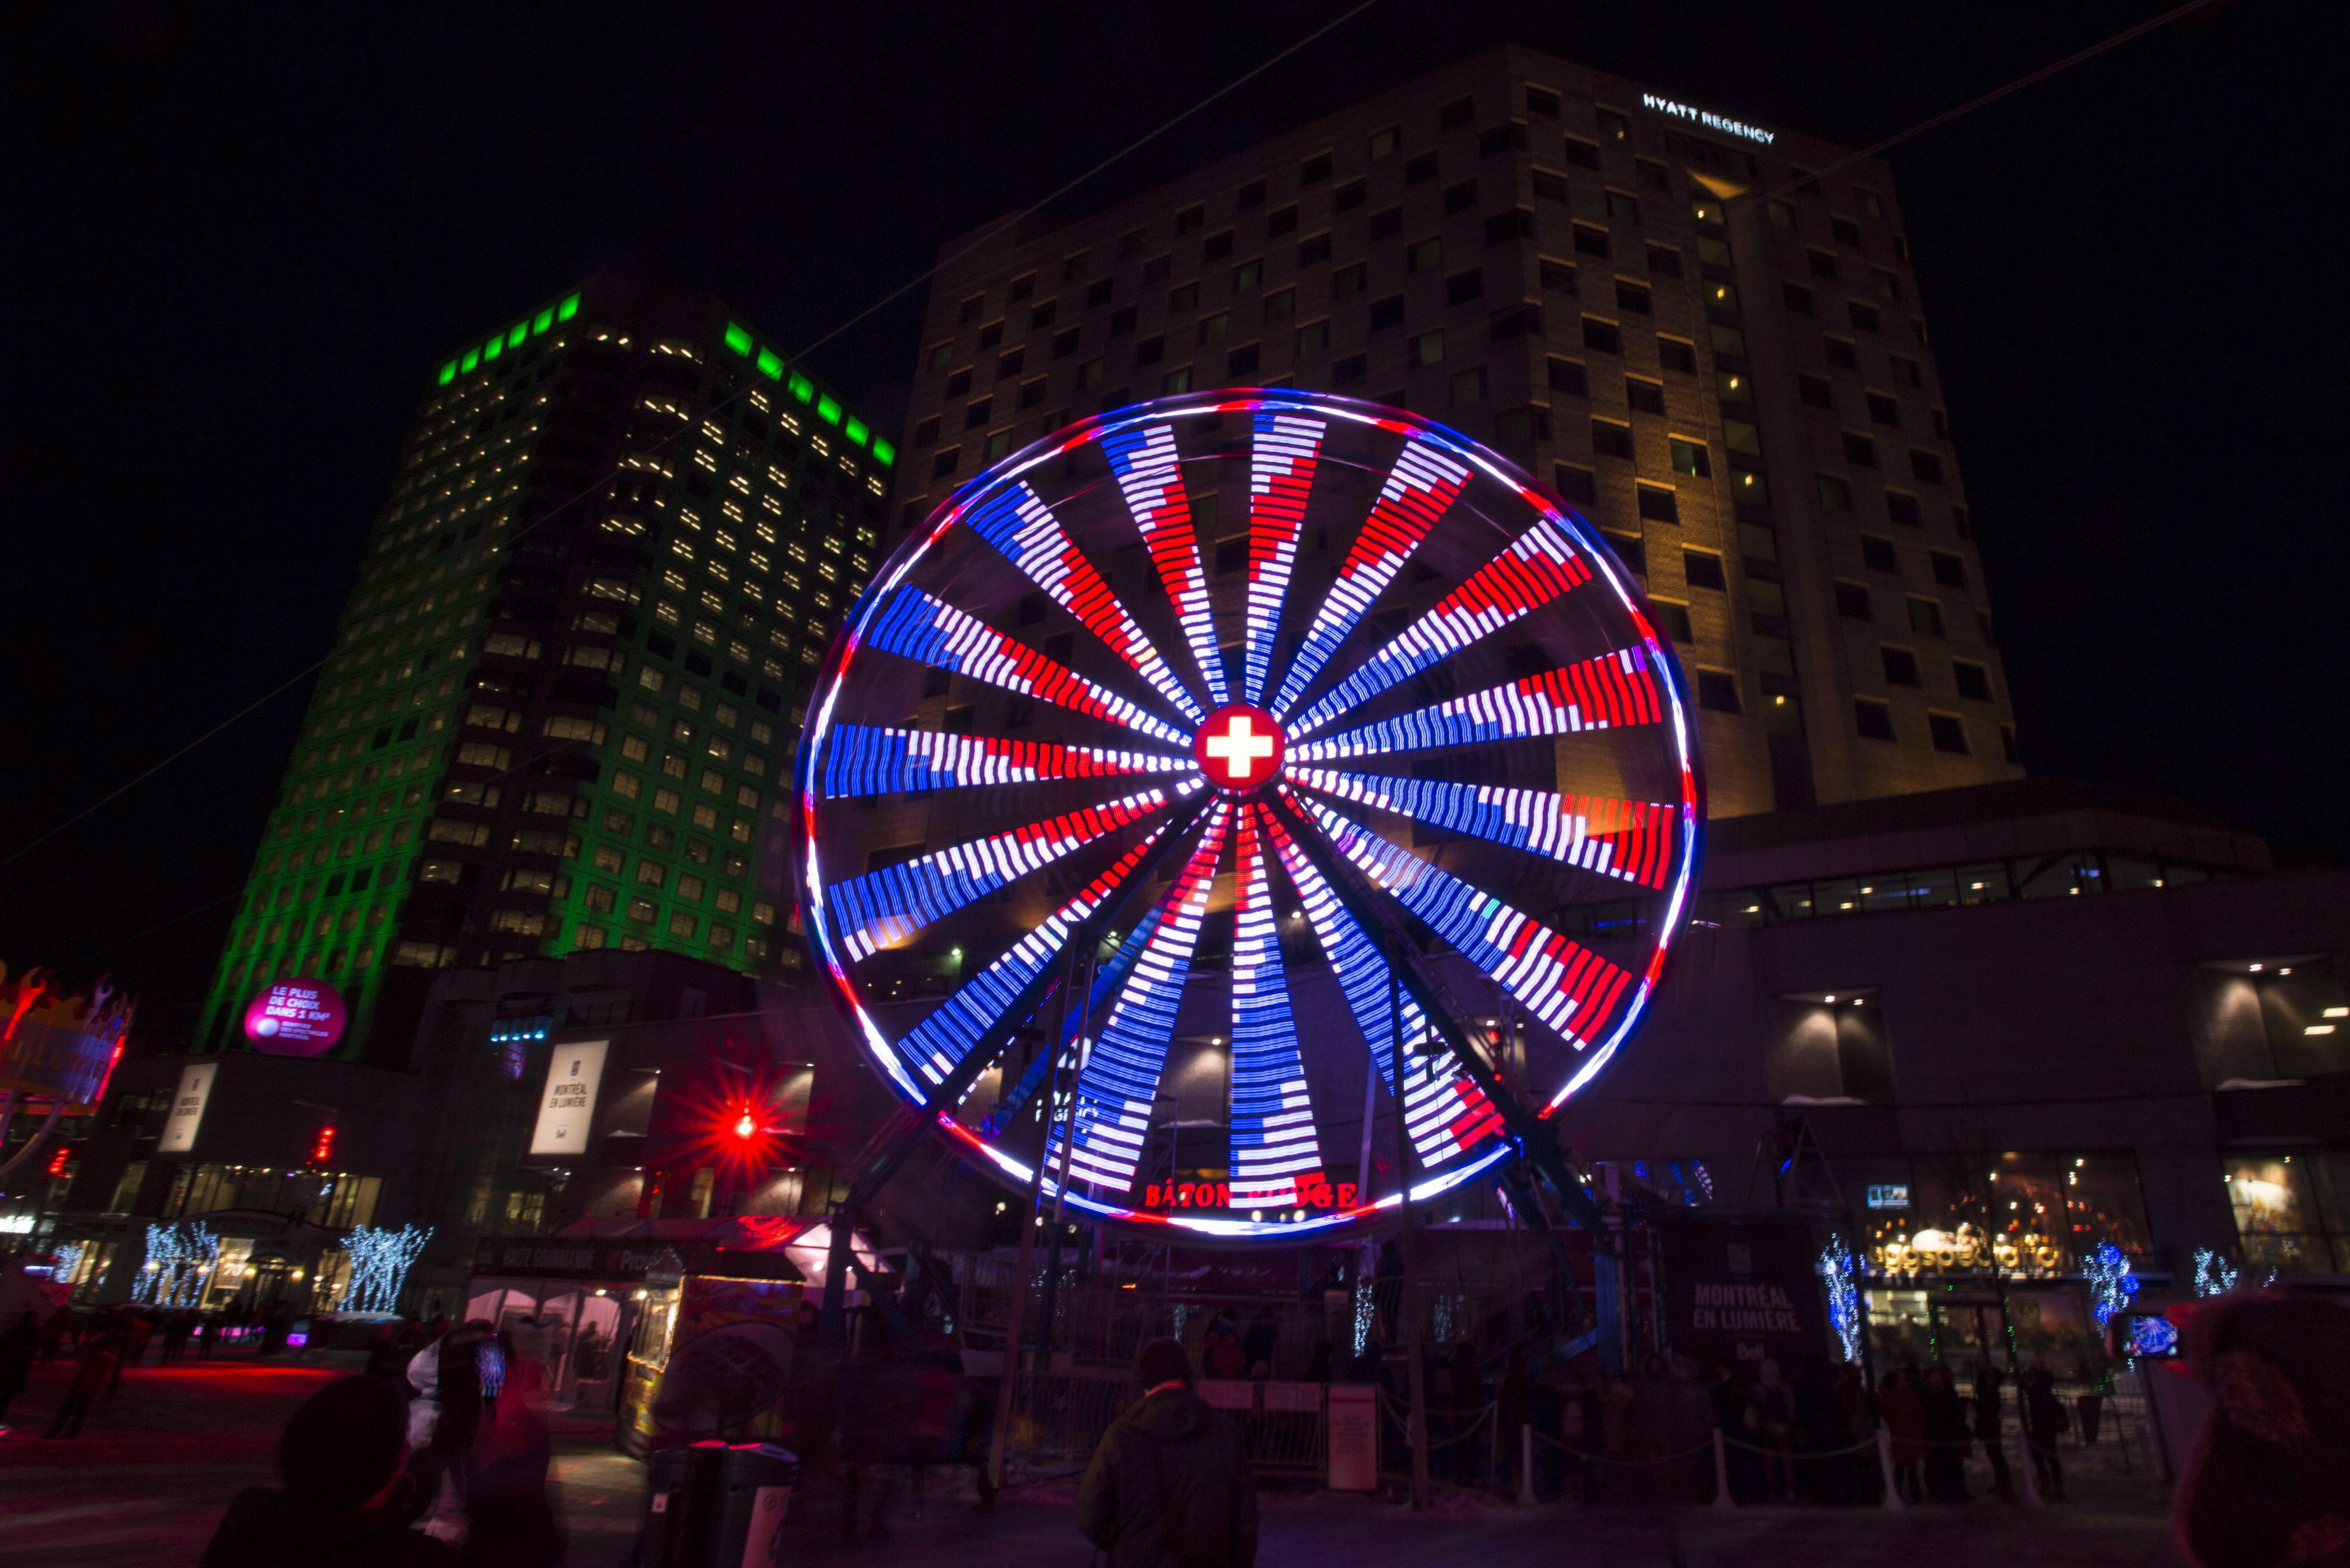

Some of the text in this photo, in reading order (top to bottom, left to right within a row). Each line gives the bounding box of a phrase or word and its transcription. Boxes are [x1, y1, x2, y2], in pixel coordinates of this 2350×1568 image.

[1643, 93, 1775, 145] HYATT REGENCY
[272, 986, 318, 1000] LE PLUS
[269, 996, 320, 1010] DE CHOIX
[265, 1005, 296, 1018] DANS
[298, 1010, 306, 1019] 1
[553, 1082, 587, 1095] MONTRÉAL
[549, 1097, 559, 1108] EN
[1695, 1282, 1794, 1309] MONTRÉAL
[1693, 1307, 1716, 1330] EN
